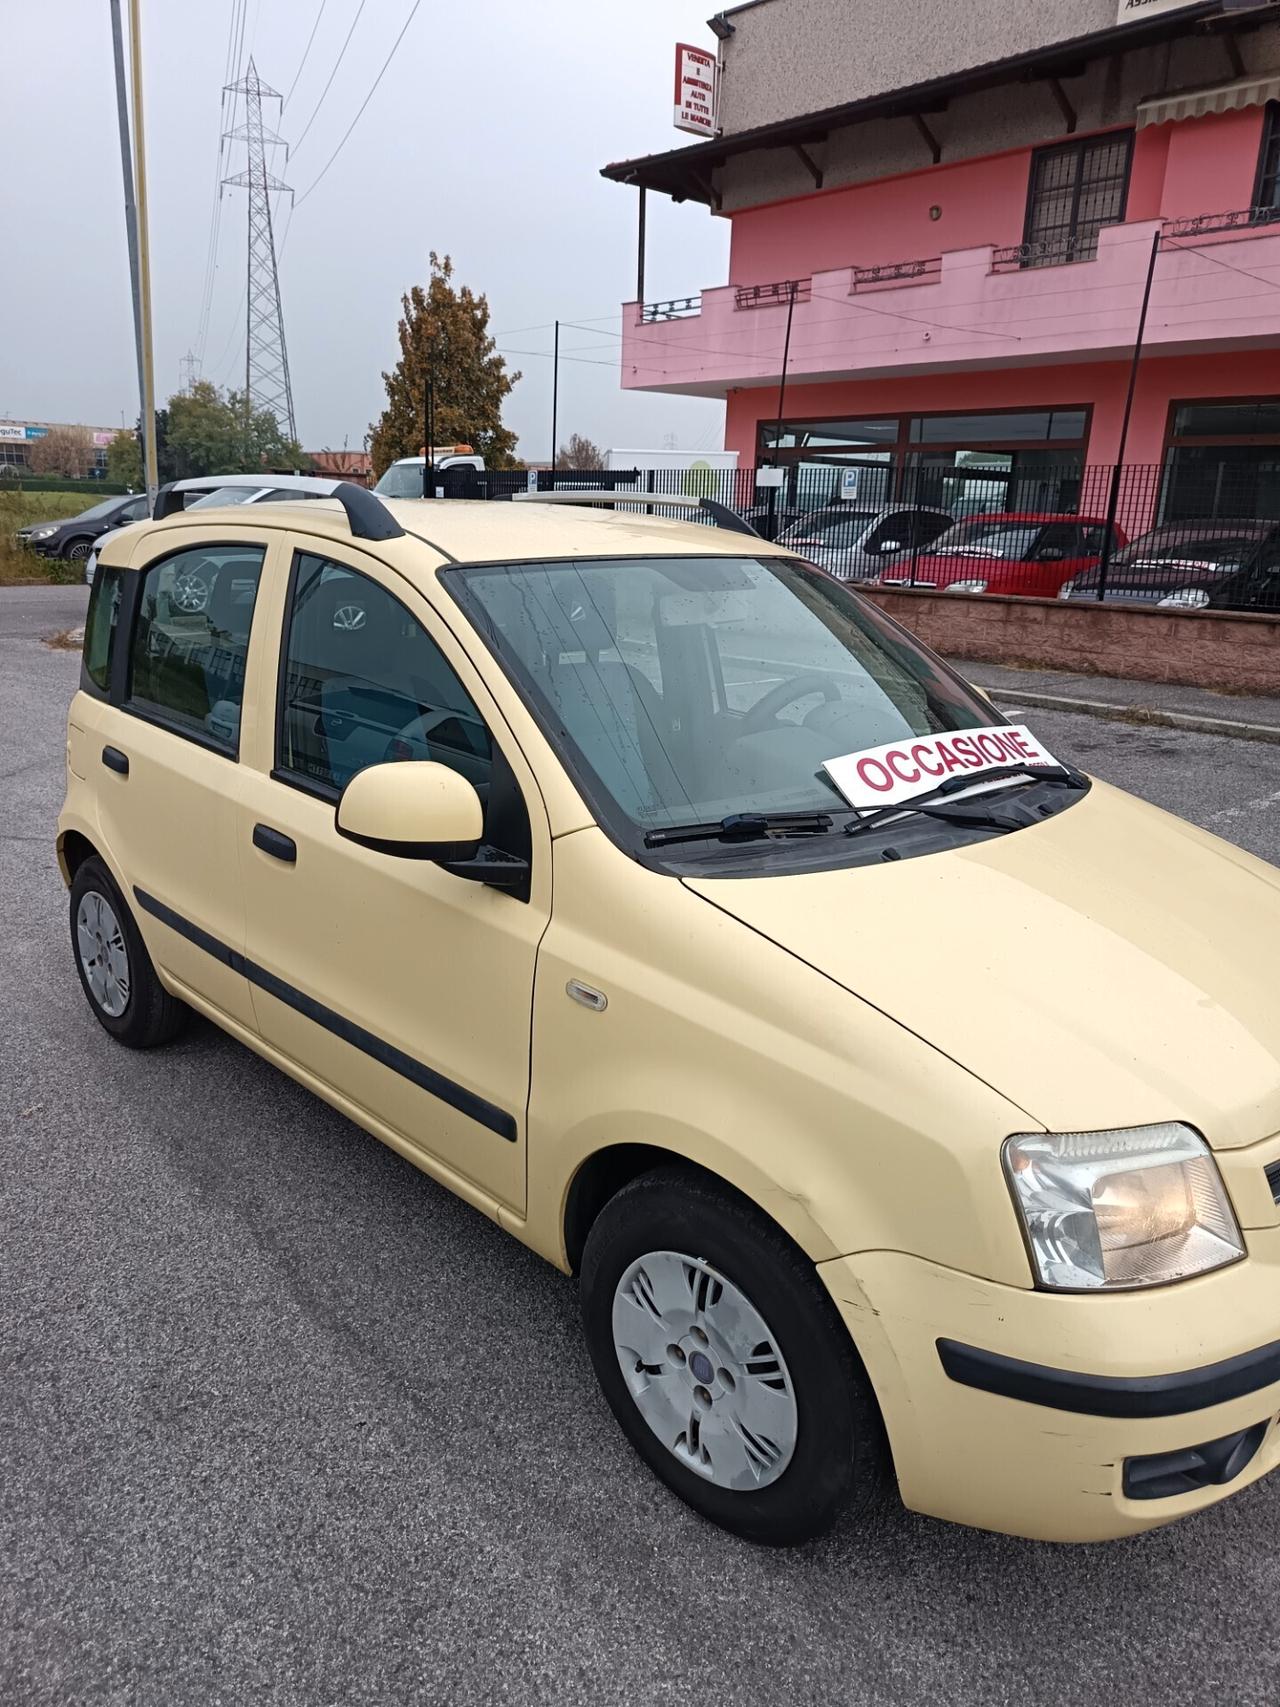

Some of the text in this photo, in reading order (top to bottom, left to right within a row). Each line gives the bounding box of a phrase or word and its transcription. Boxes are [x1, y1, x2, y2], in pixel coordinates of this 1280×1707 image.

[690, 90, 706, 102] AUTO
[693, 102, 709, 115] TUTTE
[681, 111, 689, 120] LE
[845, 471, 855, 486] P
[856, 730, 1041, 792] OCCASIONE
